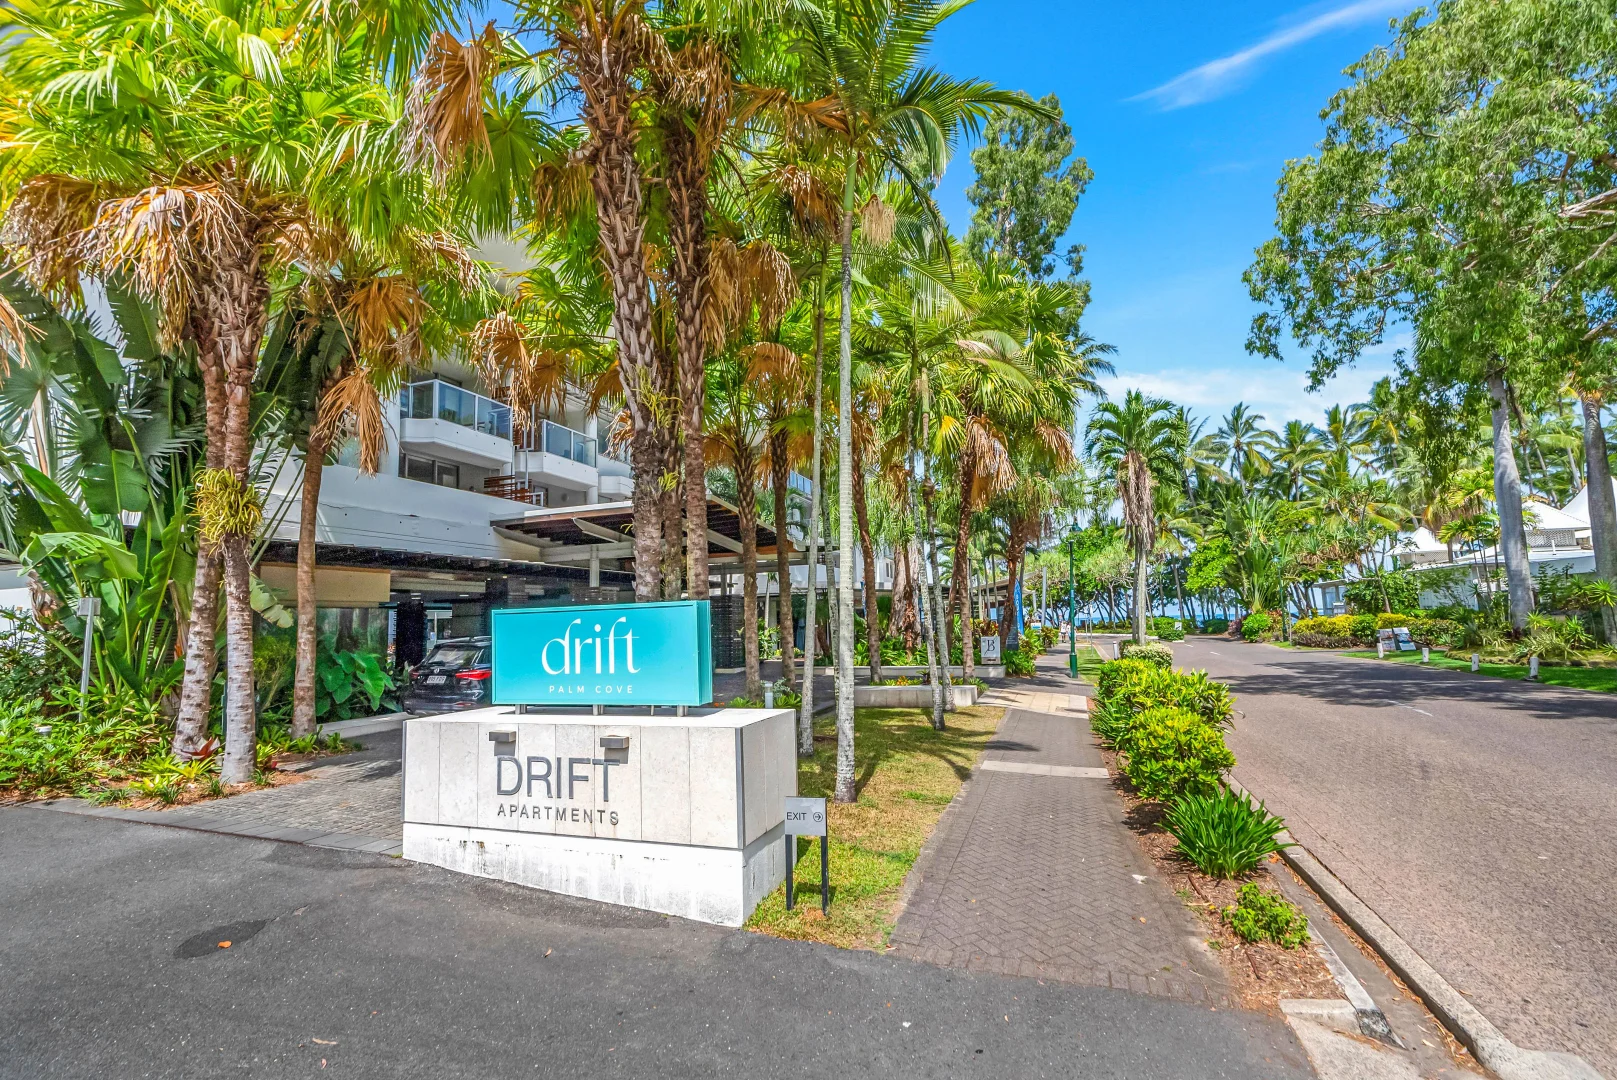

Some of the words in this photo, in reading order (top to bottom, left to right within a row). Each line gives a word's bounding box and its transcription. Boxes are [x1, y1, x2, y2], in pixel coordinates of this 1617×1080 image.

[541, 616, 641, 675] drift
[549, 685, 585, 694] PALM
[595, 685, 633, 694] COVE
[496, 755, 620, 802] DRIFT
[497, 803, 619, 826] APARTMENTS
[786, 811, 807, 821] EXIT
